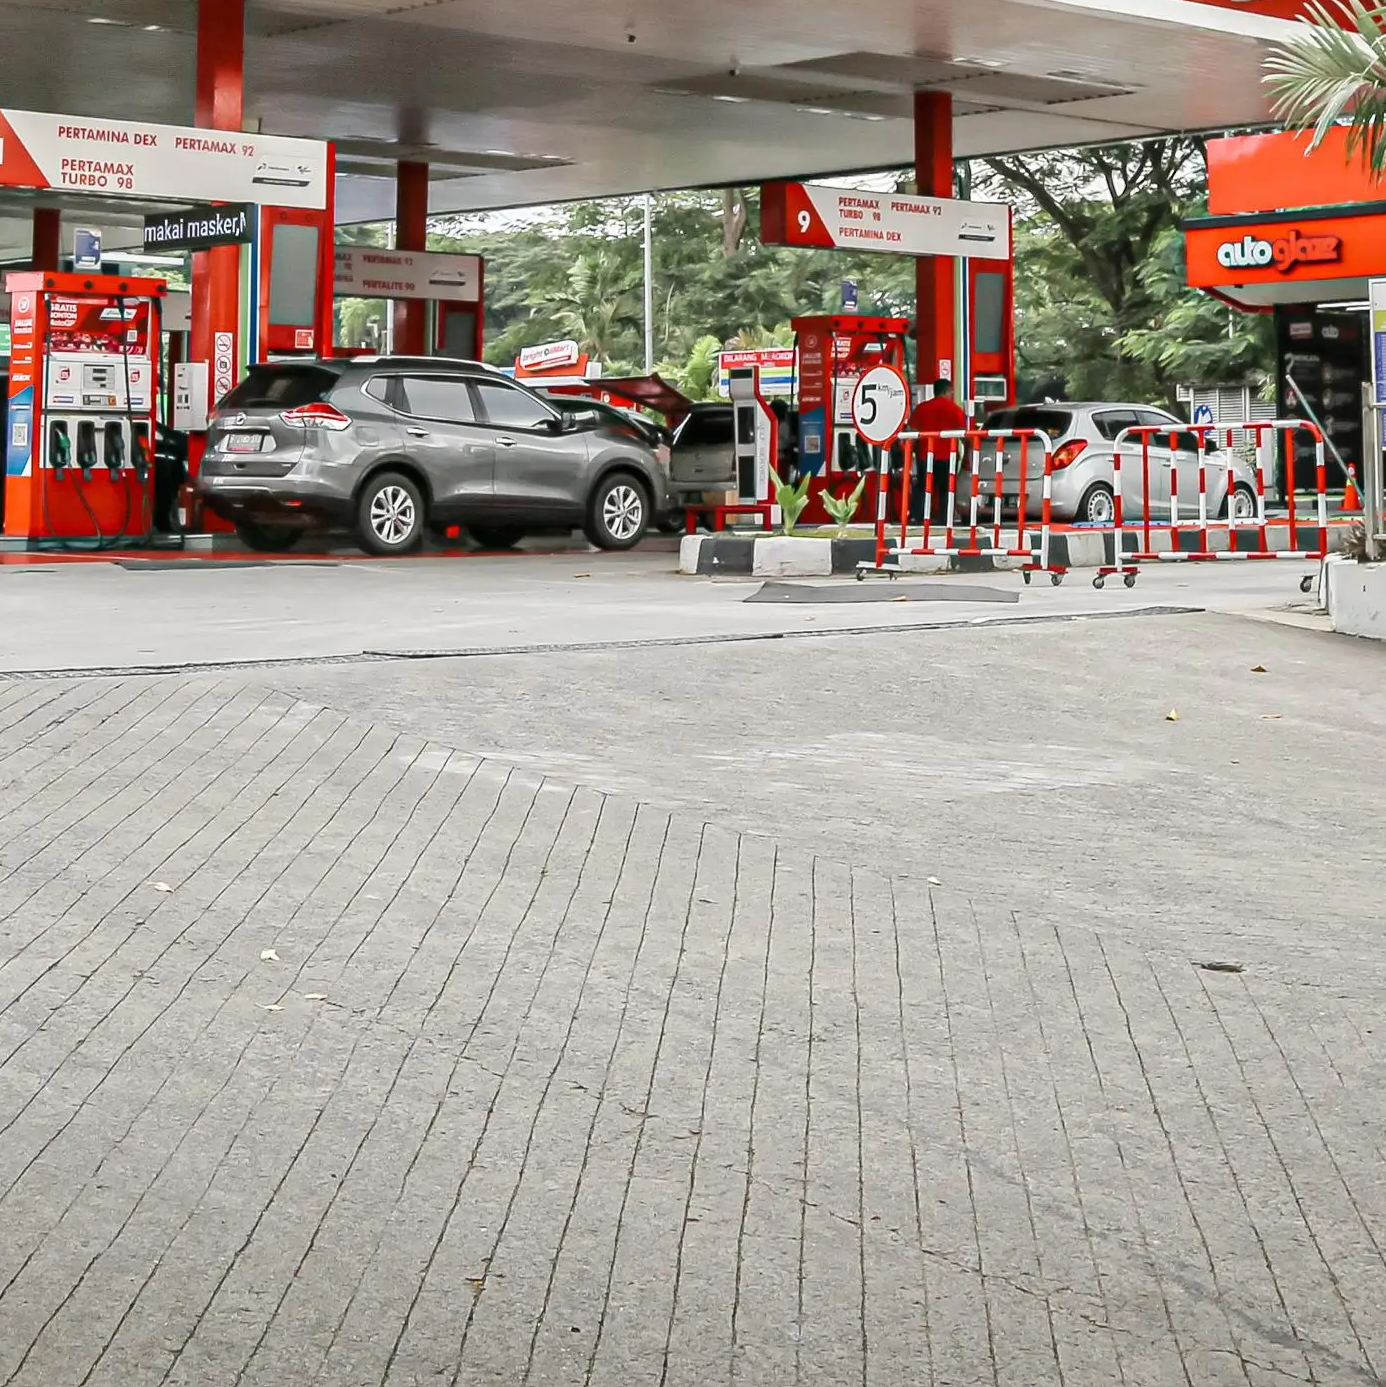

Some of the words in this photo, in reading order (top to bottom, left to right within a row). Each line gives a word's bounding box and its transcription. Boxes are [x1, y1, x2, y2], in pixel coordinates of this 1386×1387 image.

[58, 125, 130, 144] PERTAMINA
[133, 130, 158, 147] DEX
[175, 137, 237, 155] PERTAMAX
[241, 144, 255, 157] 92
[61, 158, 134, 176] PERTAMAX
[61, 172, 108, 188] TURBO
[117, 177, 134, 190] 98
[838, 197, 880, 210] PERTAMAX
[890, 202, 931, 215] PERTAMAX
[797, 210, 811, 233] 9
[839, 209, 864, 220] TURBO
[144, 217, 184, 242] makai
[839, 227, 884, 240] PERTAMINA
[886, 231, 902, 242] DEX
[860, 383, 878, 425] 5
